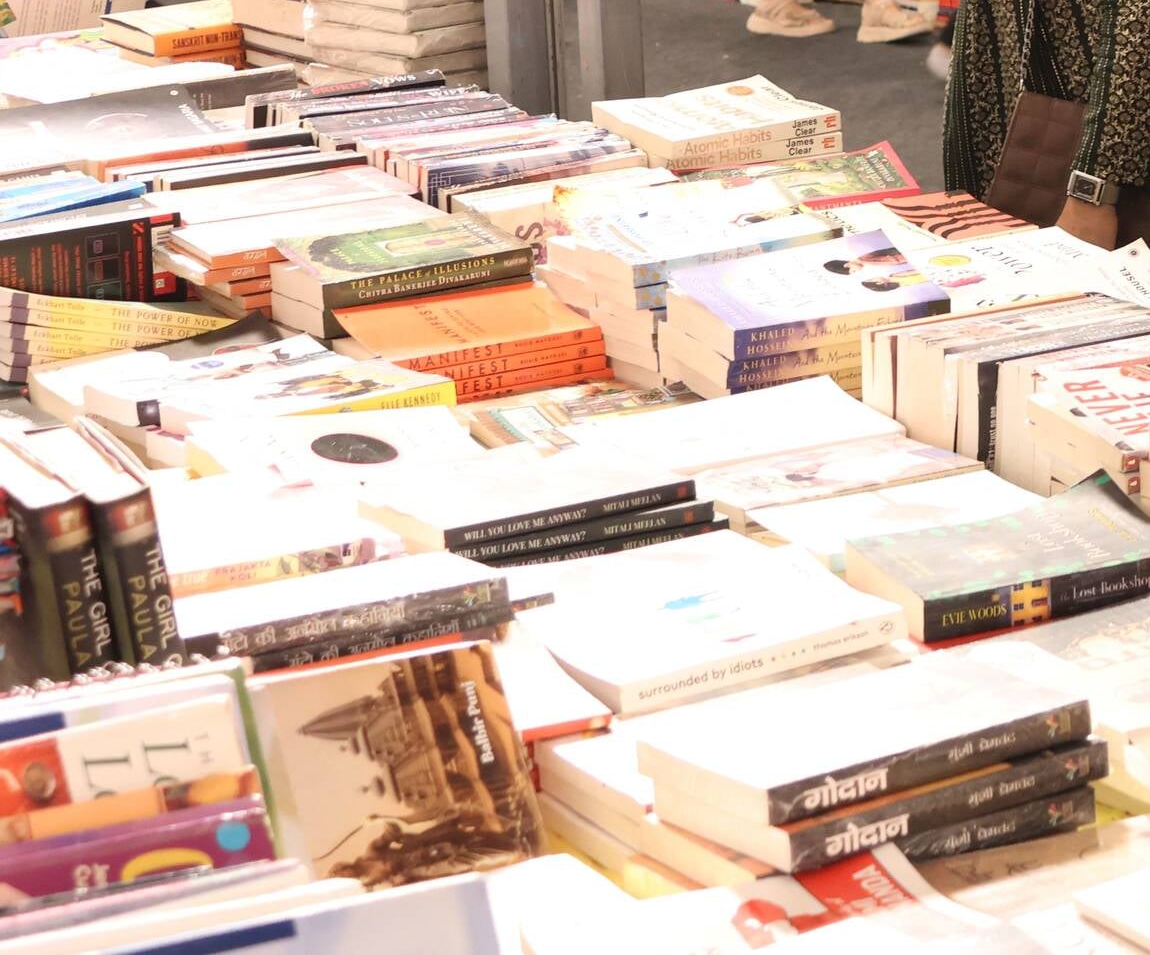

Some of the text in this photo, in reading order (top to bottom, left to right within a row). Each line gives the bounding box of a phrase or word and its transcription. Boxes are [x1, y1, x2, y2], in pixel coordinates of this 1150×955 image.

[172, 31, 205, 49] SANSKRIT
[792, 116, 818, 129] James
[795, 125, 816, 137] Clear
[684, 129, 772, 155] Atomic Habits
[785, 138, 814, 149] James
[788, 145, 812, 156] Clear
[666, 147, 762, 169] Atomic Habits
[350, 277, 374, 290] THE
[379, 270, 424, 285] PALACE
[433, 256, 496, 276] ILLUSIONS
[1118, 265, 1150, 296] HOUSEL
[36, 299, 61, 310] Eckhart
[62, 301, 86, 312] Tolle
[110, 307, 132, 318] THE
[136, 310, 172, 324] POWER
[178, 315, 193, 326] OF
[33, 327, 129, 347] Eckhart Tolle THE
[36, 313, 61, 324] Eckhart
[62, 316, 86, 326] Tolle
[112, 321, 133, 332] THE
[136, 324, 173, 337] POWER
[751, 327, 796, 343] KHALED
[36, 344, 63, 354] Eckhart
[409, 342, 504, 370] MANIFEST
[446, 358, 509, 380] NIFEST
[742, 354, 787, 371] KHALED
[462, 375, 504, 394] FEST
[402, 391, 441, 408] KENNEDY
[1063, 379, 1150, 437] NEVER
[464, 529, 487, 542] WILL
[488, 524, 507, 538] YOU
[507, 520, 531, 534] LOVE
[531, 517, 546, 529] ME
[547, 508, 587, 526] ANYWAY?
[603, 499, 630, 512] MITALI
[480, 544, 500, 557] YOU
[502, 540, 526, 554] LOVE
[526, 537, 542, 549] ME
[543, 531, 587, 547] ANYWAY?
[603, 522, 631, 536] MITALI
[214, 560, 272, 579] PRAJAKTA
[230, 571, 258, 583] KOLI
[80, 547, 111, 657] THE GIRL
[145, 545, 180, 659] THE GIRL
[1072, 584, 1098, 601] Lost
[62, 581, 89, 667] PAULA
[127, 574, 157, 662] PAULA
[942, 603, 1008, 628] EVIE WOODS
[637, 656, 765, 702] surrounded by idiots
[471, 717, 495, 765] Balbir
[803, 767, 889, 810] गोदान
[825, 813, 910, 858] गोदान
